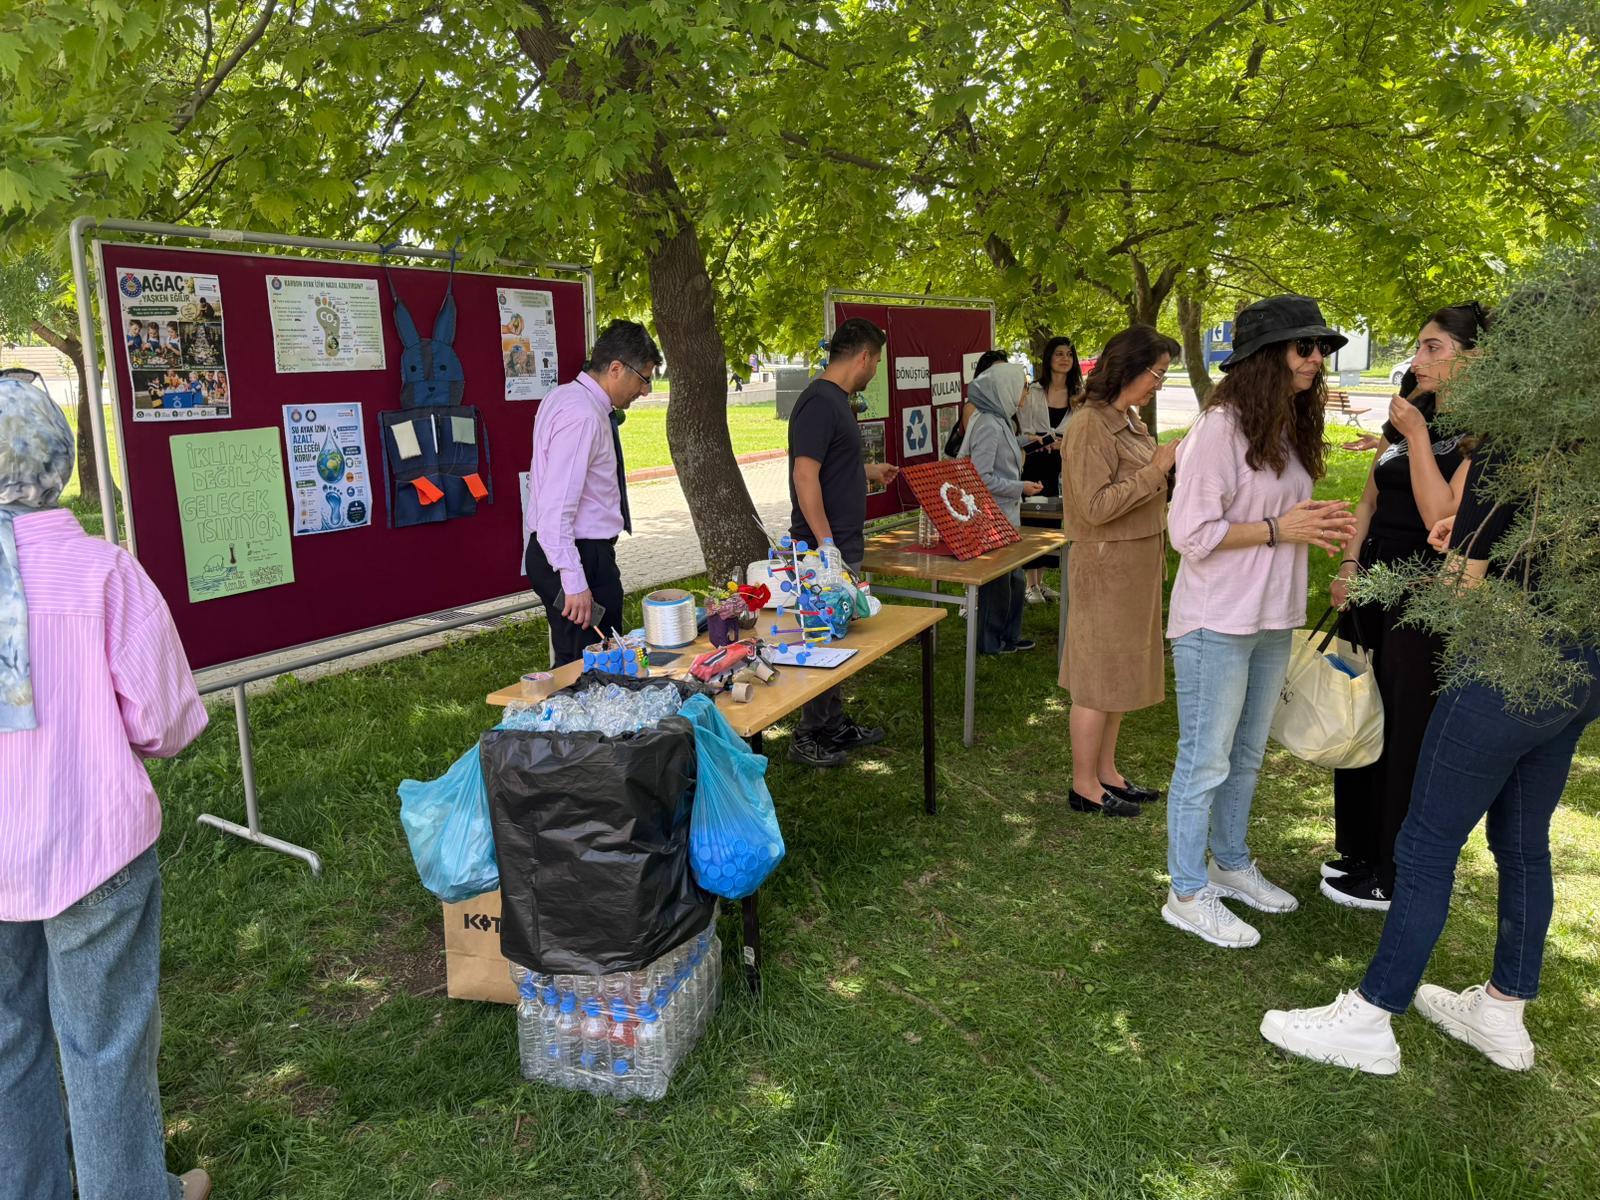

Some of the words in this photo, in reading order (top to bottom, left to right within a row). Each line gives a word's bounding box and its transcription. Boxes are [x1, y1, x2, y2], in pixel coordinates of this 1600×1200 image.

[142, 273, 185, 294] AĞAÇ
[142, 294, 169, 304] YAŞKEN
[170, 293, 191, 303] EĞİLİR
[896, 366, 930, 382] DÖNÜŞTÜR
[932, 380, 961, 397] KULLAN
[292, 425, 299, 434] SU
[300, 425, 314, 434] AYAK
[315, 424, 326, 433] İZİNİ
[293, 434, 315, 444] AZALT,
[186, 441, 248, 469] İKLİM
[293, 442, 320, 454] GELECEĞİ
[192, 466, 251, 491] DEĞİL
[182, 490, 269, 522] GELECEK
